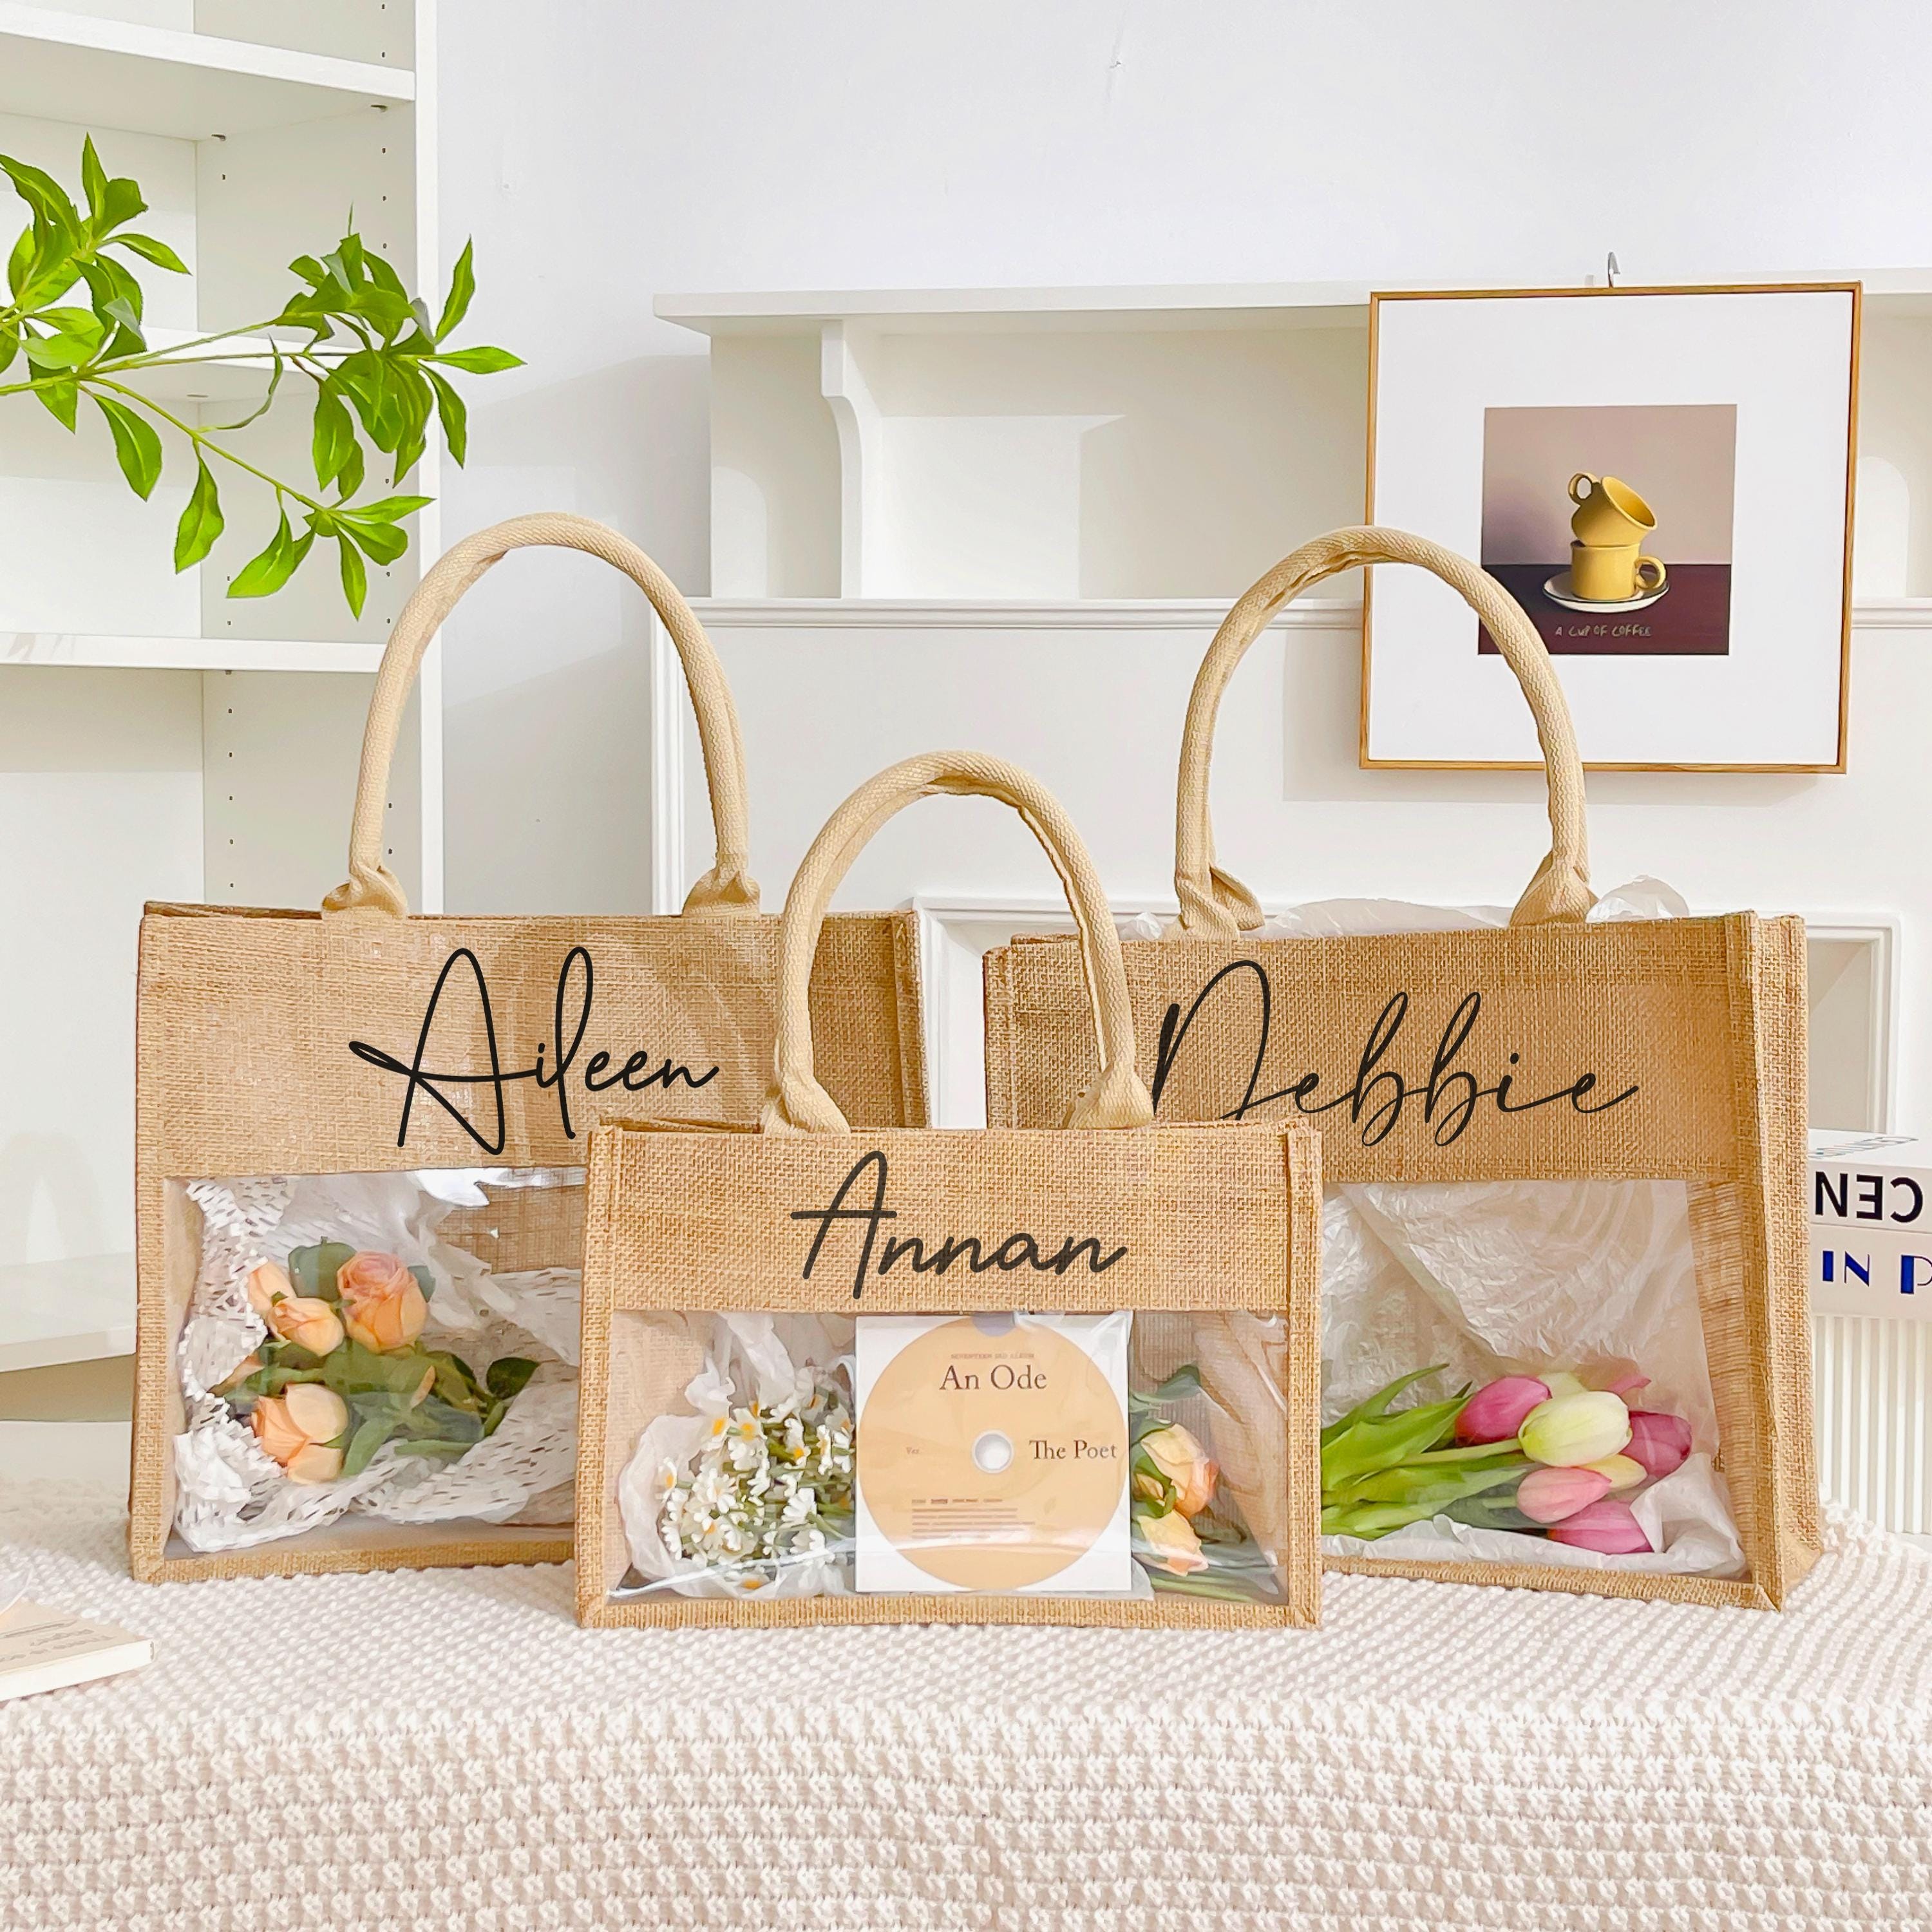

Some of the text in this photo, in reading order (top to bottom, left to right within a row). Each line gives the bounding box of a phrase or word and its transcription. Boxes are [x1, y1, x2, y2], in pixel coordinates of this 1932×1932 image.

[1555, 626, 1563, 636] A
[1593, 624, 1609, 637] OF
[1611, 623, 1652, 637] COFFEE
[349, 947, 719, 1155] Aileen
[1152, 960, 1639, 1147] Debbie
[790, 1150, 1128, 1300] Annan
[939, 1364, 1047, 1390] An Ode
[1028, 1439, 1117, 1460] The Poet
